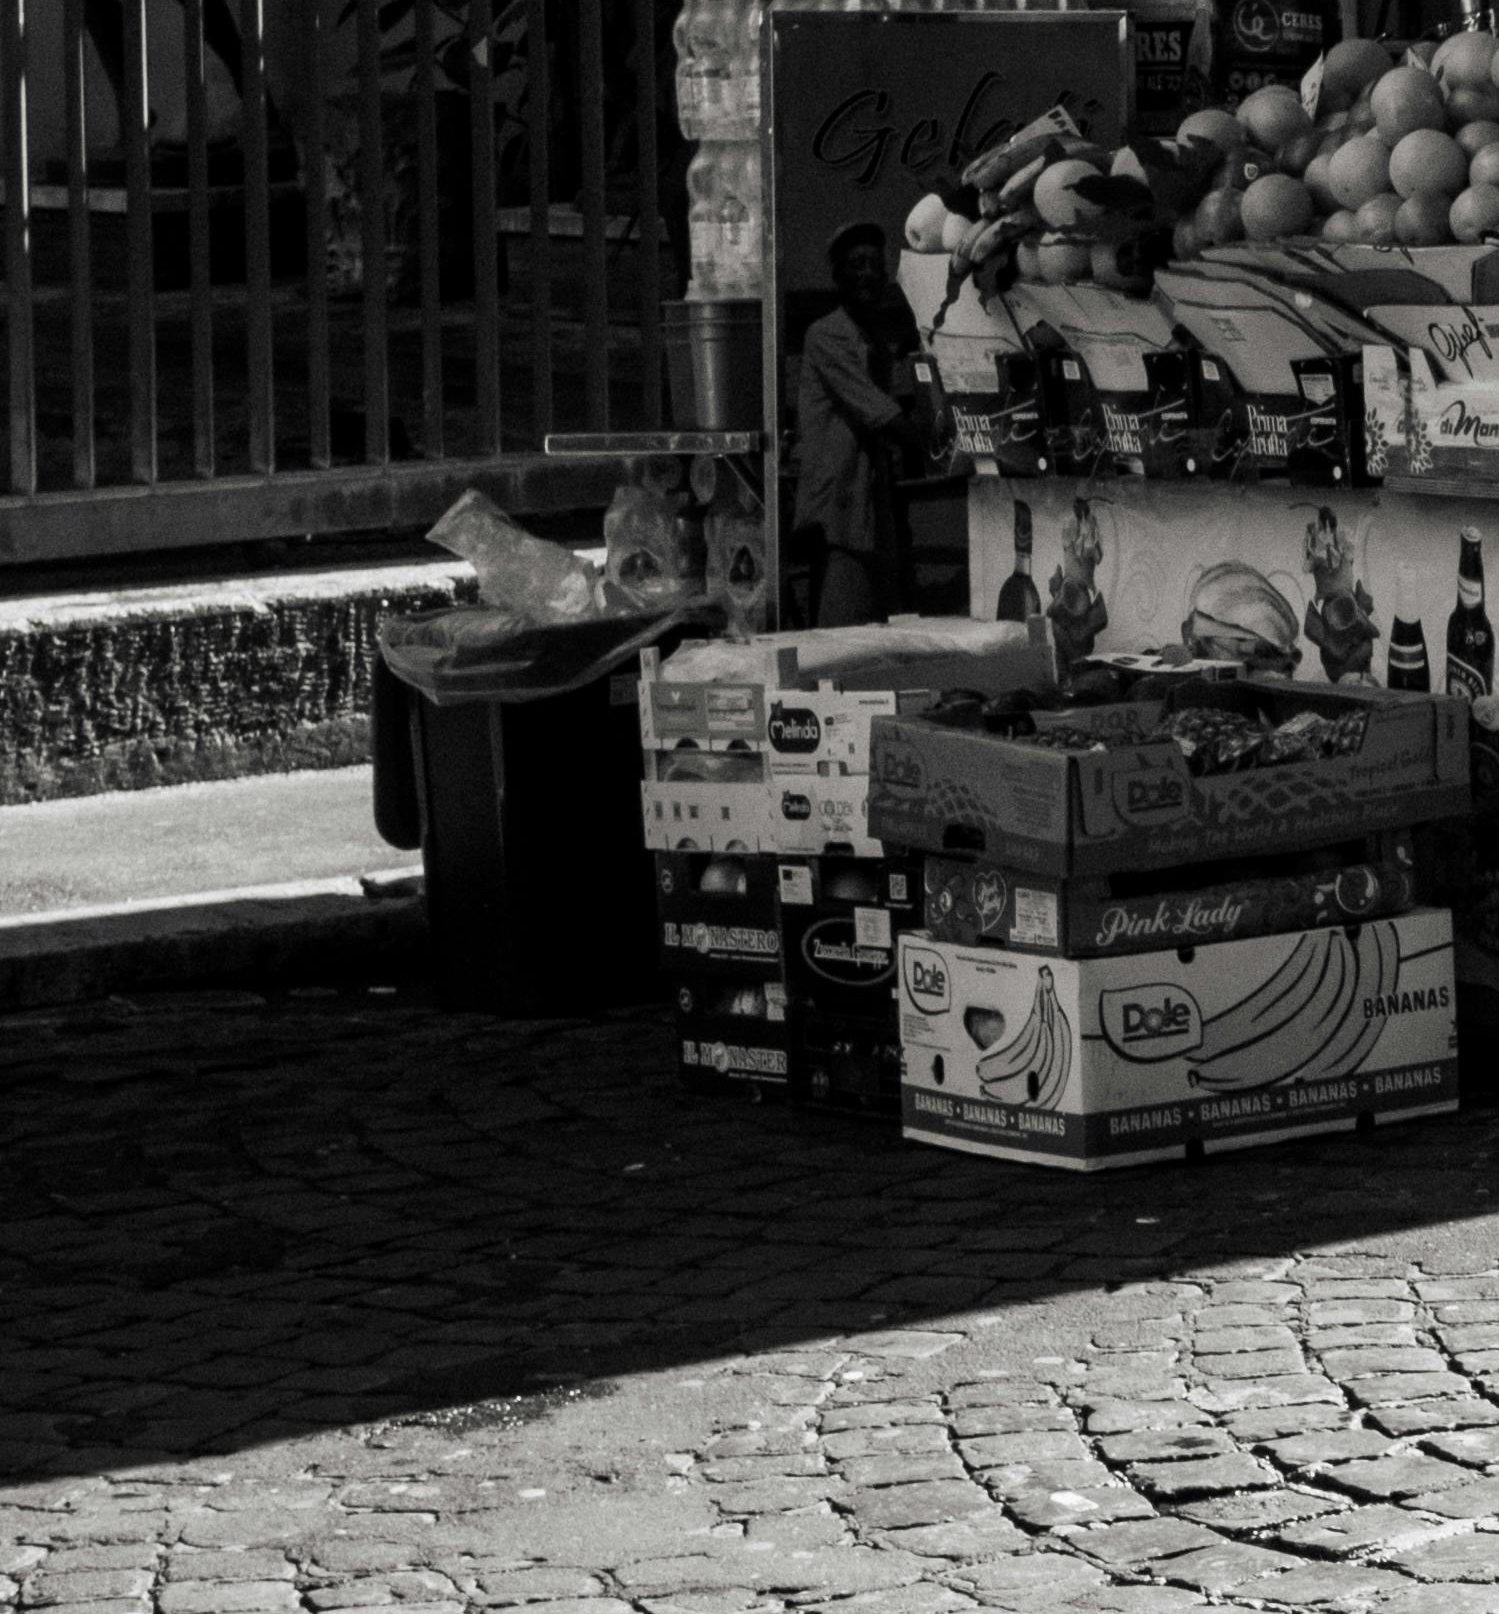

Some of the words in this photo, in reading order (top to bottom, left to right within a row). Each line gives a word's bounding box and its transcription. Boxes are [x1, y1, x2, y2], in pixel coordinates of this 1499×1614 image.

[1280, 11, 1324, 31] CERES
[1135, 30, 1183, 63] RES
[769, 717, 820, 740] Melinda
[1127, 776, 1183, 805] Dole
[1096, 900, 1169, 947] Pink
[1173, 894, 1242, 935] Lady
[663, 921, 681, 947] IL
[680, 922, 780, 954] MONASTERO
[913, 961, 945, 992] Dole
[1122, 996, 1191, 1036] Dole
[1363, 986, 1450, 1020] BANANAS
[682, 1040, 700, 1065] IL
[699, 1042, 788, 1075] MONASTER
[914, 1092, 954, 1117] BANANAS
[963, 1103, 1008, 1127] BANANAS
[1017, 1112, 1066, 1137] BANANAS
[1109, 1105, 1183, 1135] BANANAS
[1200, 1094, 1271, 1121] BANANAS
[1288, 1081, 1358, 1107] BANANAS
[1374, 1067, 1442, 1094] BANANAS
